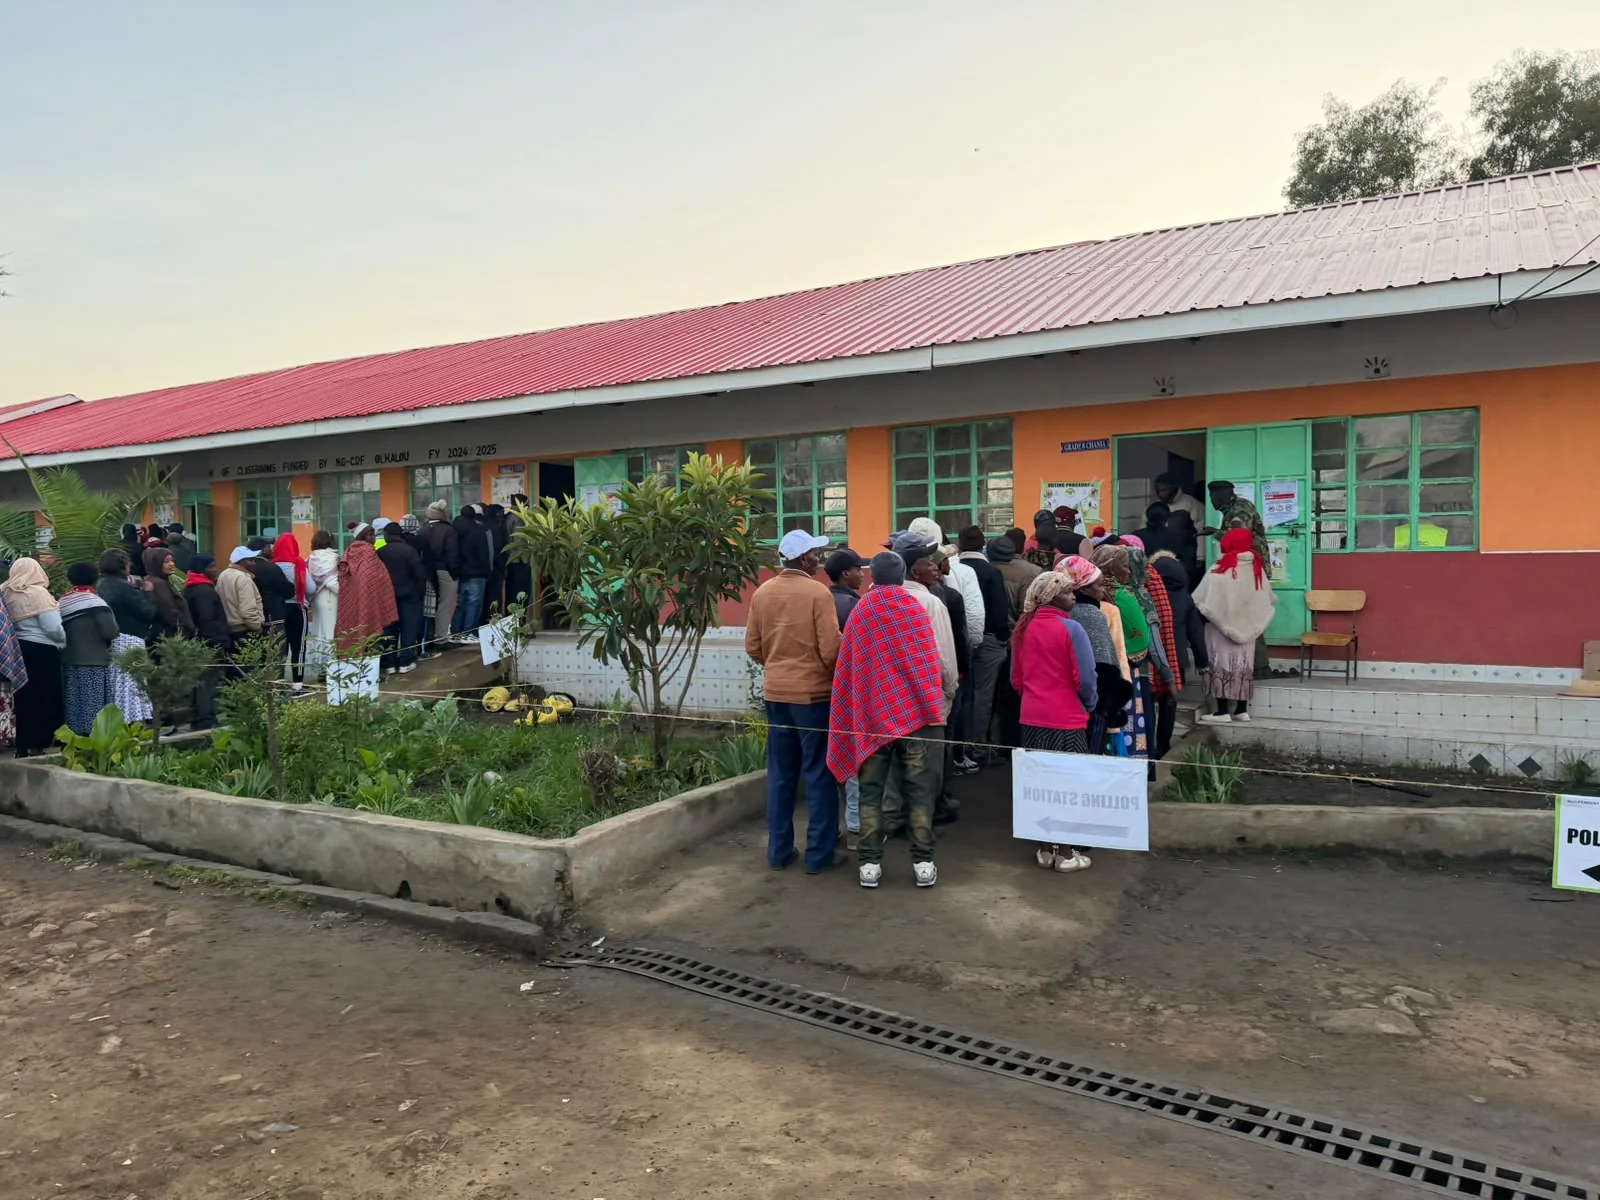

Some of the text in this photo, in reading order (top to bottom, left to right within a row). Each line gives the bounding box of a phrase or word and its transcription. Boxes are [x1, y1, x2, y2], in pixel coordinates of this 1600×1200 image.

[1064, 442, 1080, 450] GRADE
[282, 460, 309, 472] FUNDED
[318, 458, 328, 469] BY
[335, 455, 365, 467] NG-CDF
[375, 451, 410, 464] OLKALOU
[428, 449, 440, 460] FY
